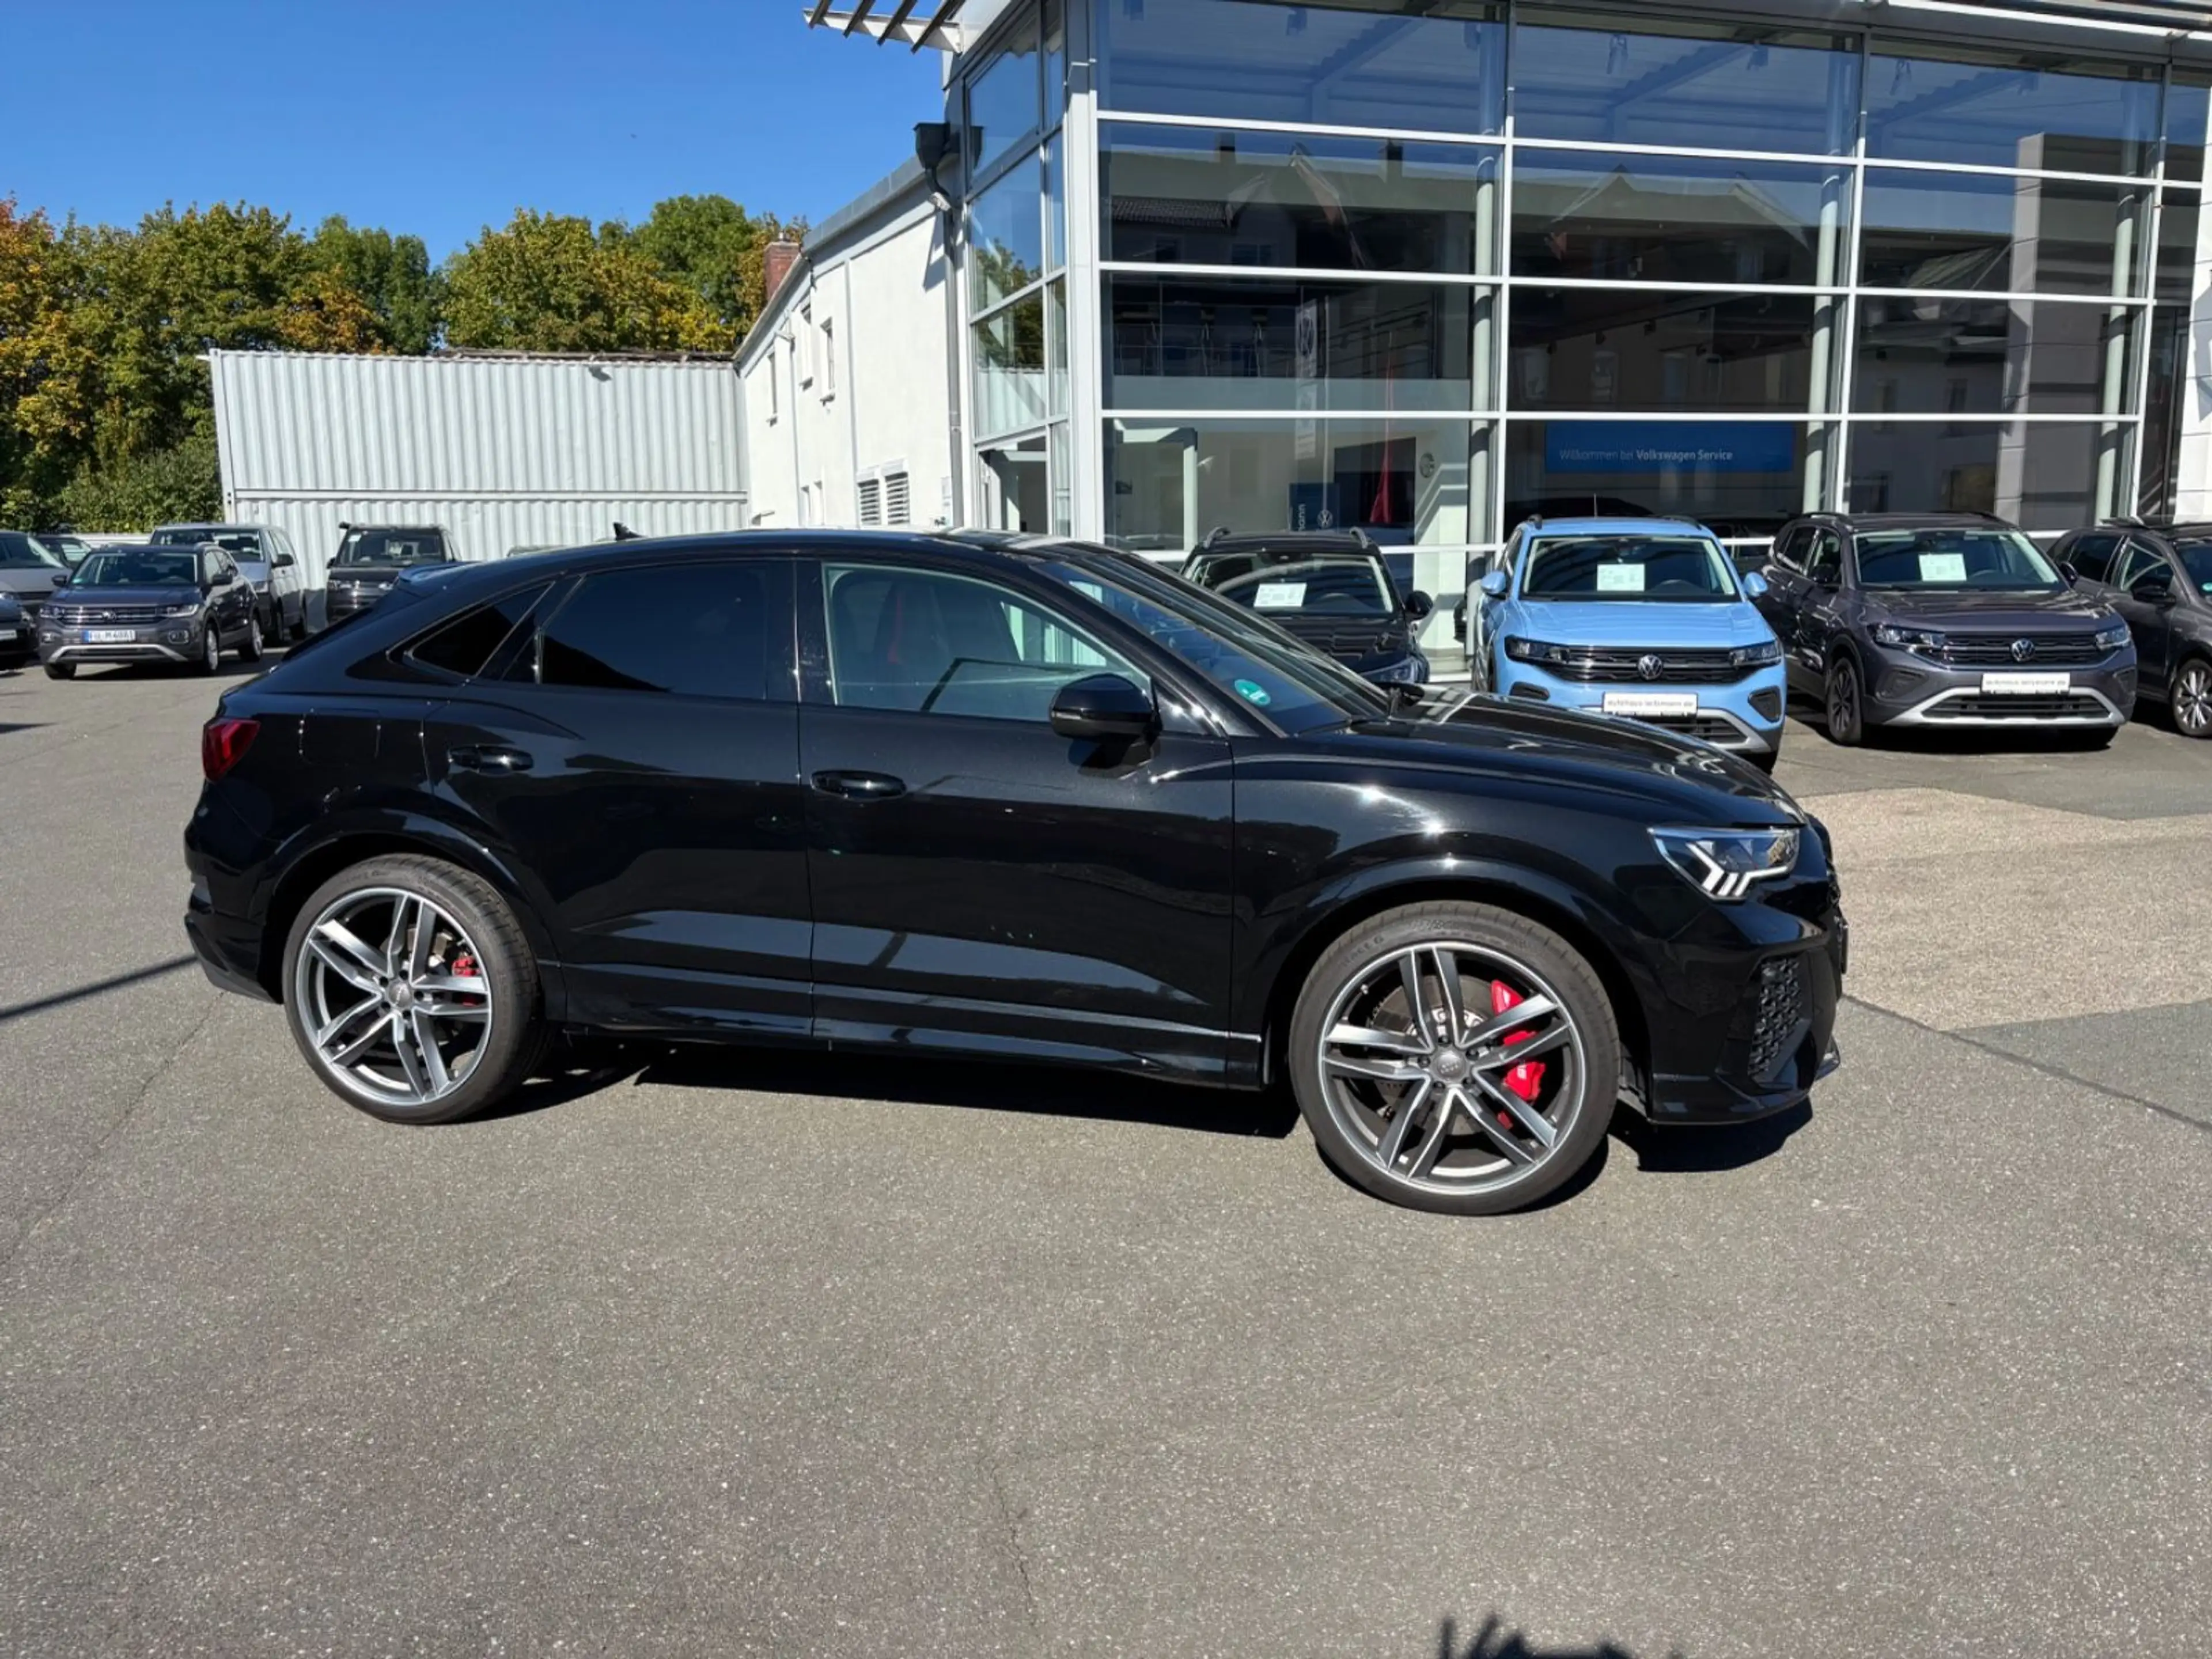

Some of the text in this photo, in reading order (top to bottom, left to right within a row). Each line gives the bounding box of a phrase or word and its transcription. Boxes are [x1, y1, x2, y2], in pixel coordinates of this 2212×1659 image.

[1559, 448, 1733, 463] Willkommen bei Volkswagen Service
